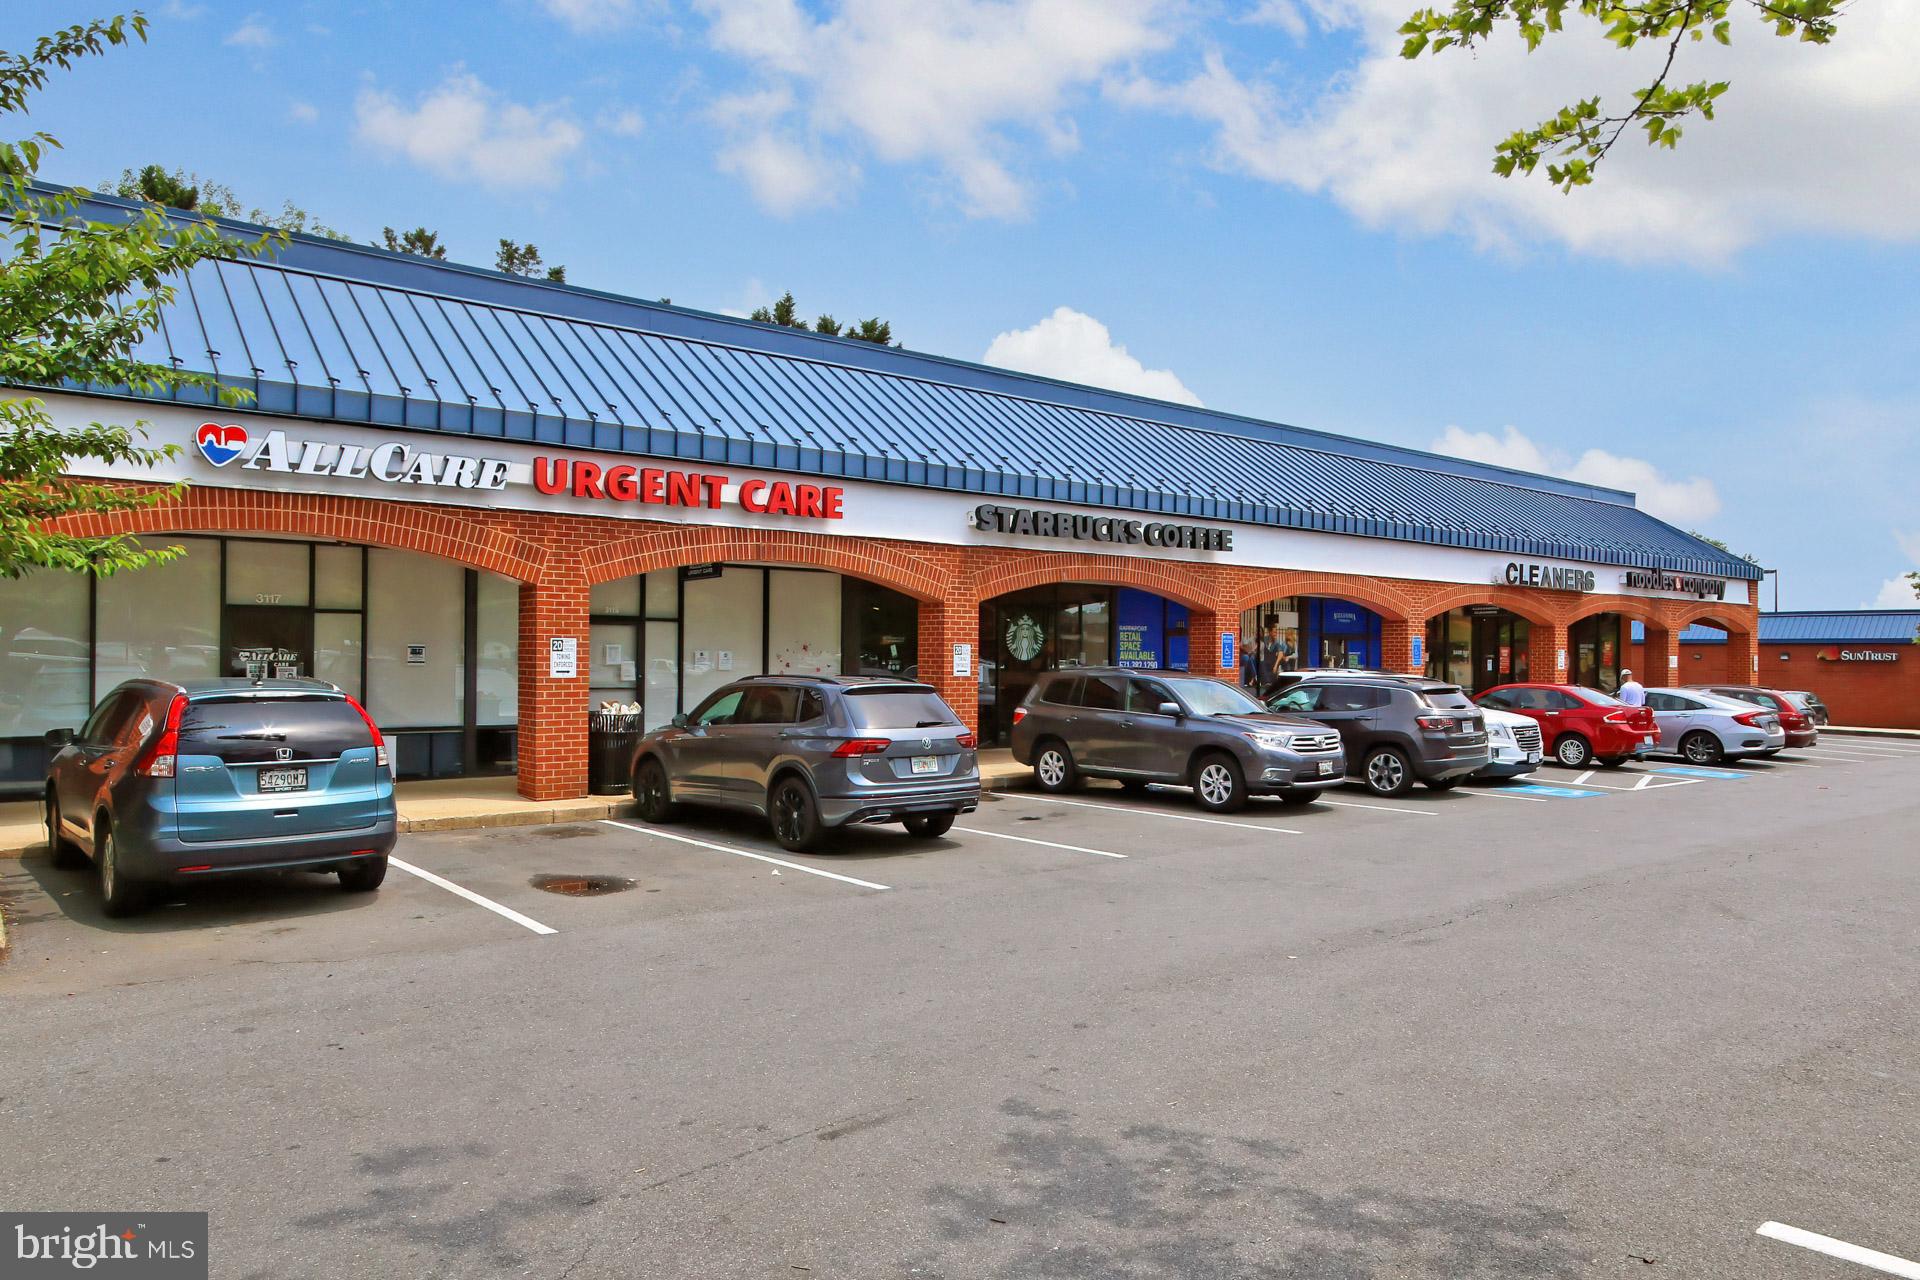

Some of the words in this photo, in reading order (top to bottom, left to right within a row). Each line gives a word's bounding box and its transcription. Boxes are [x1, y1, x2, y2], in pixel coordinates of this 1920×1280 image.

[533, 456, 728, 509] URGENT
[739, 479, 843, 520] CARE
[975, 504, 1142, 544] STARBUCKS
[1143, 522, 1233, 552] COFFEE
[1505, 562, 1595, 592] CLEANERS
[255, 593, 282, 604] 3117
[1119, 632, 1142, 641] RETAIL
[552, 640, 563, 651] 20
[1119, 642, 1141, 650] SPACE
[1119, 652, 1155, 660] AVAILABLE
